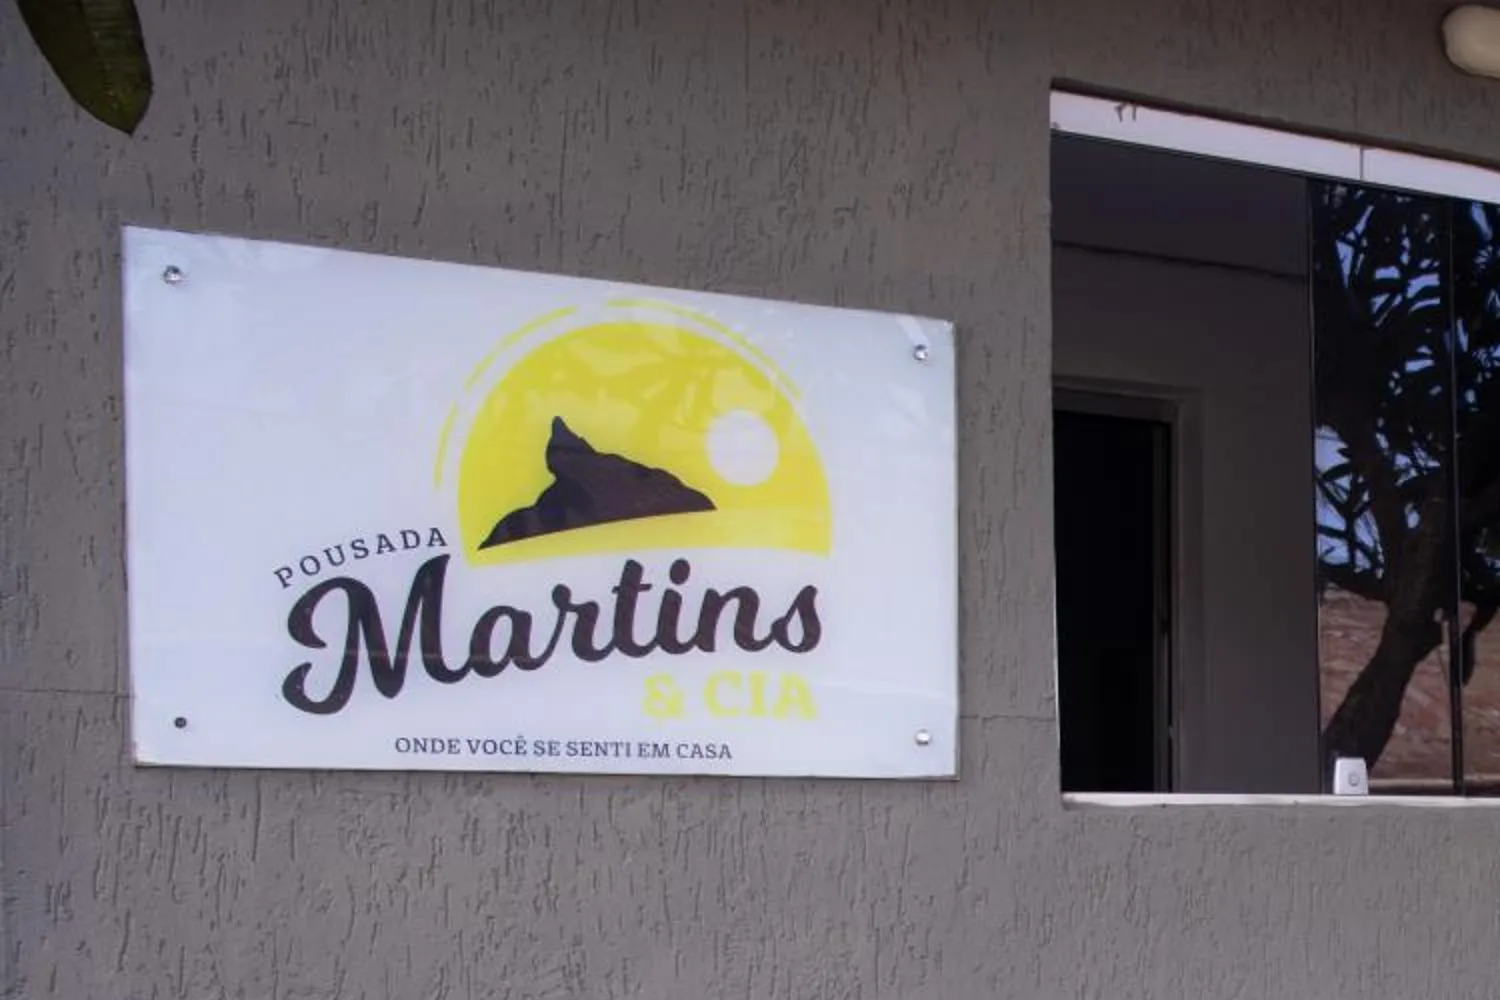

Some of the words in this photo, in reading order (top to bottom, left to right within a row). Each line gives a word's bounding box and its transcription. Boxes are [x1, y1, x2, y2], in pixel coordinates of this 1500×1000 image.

[273, 526, 448, 589] POUSADA
[281, 553, 822, 715] Martins
[642, 671, 685, 720] &
[703, 670, 818, 720] CIA
[394, 736, 461, 755] ONDE
[466, 735, 528, 756] VOCÊ
[533, 740, 561, 757] SE
[565, 740, 632, 758] SENTI
[637, 742, 671, 759] EM
[676, 742, 733, 760] CASA
